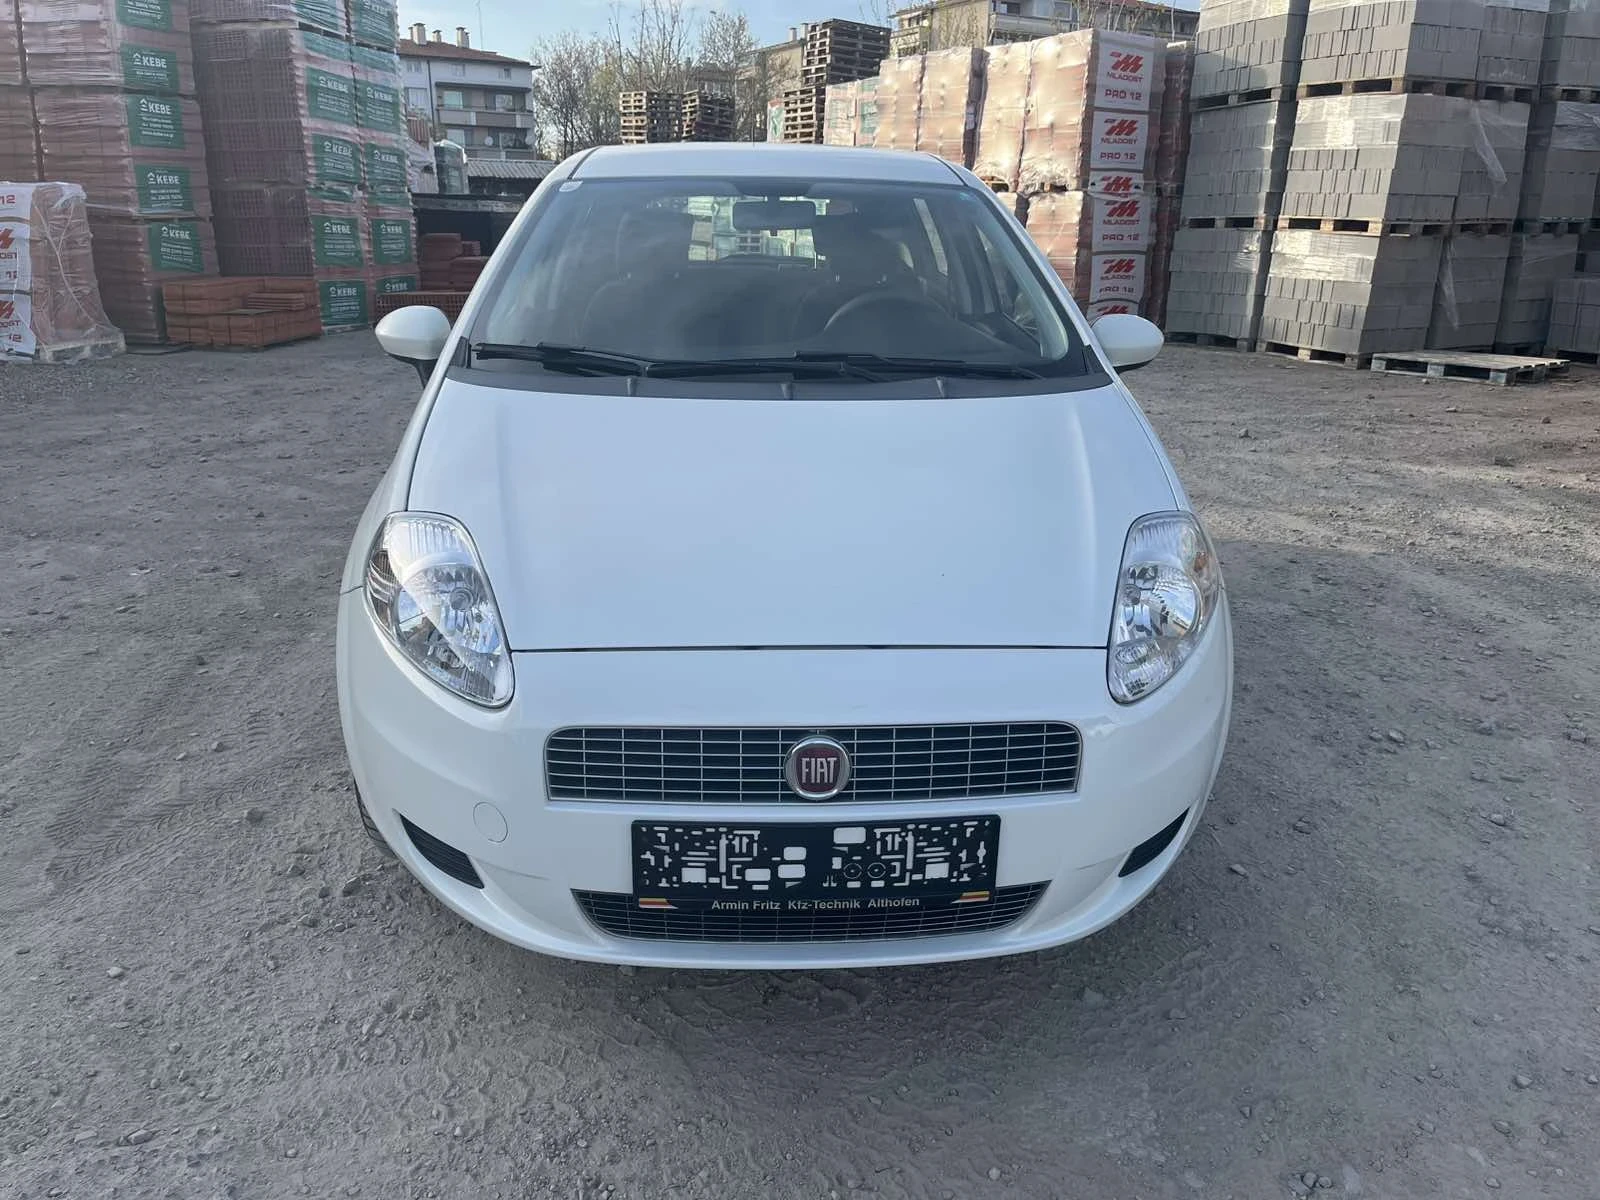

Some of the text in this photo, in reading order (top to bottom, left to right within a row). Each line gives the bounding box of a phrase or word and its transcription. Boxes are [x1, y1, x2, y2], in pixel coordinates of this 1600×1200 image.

[142, 55, 167, 69] KEBE
[1107, 72, 1143, 82] MLADOST
[1105, 89, 1142, 100] PRO 12
[148, 102, 172, 115] KEBE
[1125, 152, 1137, 160] 12
[156, 174, 180, 185] KEBE
[332, 223, 351, 234] KEBE
[387, 225, 403, 234] KEBE
[169, 229, 191, 240] KEBE
[1103, 233, 1140, 241] PRO 12
[337, 287, 357, 297] KEBE
[391, 283, 408, 291] KEBE
[1122, 285, 1134, 293] 12
[801, 757, 837, 784] FIAT
[711, 896, 920, 910] Armin Fritz Kfz-Technik Althofen
